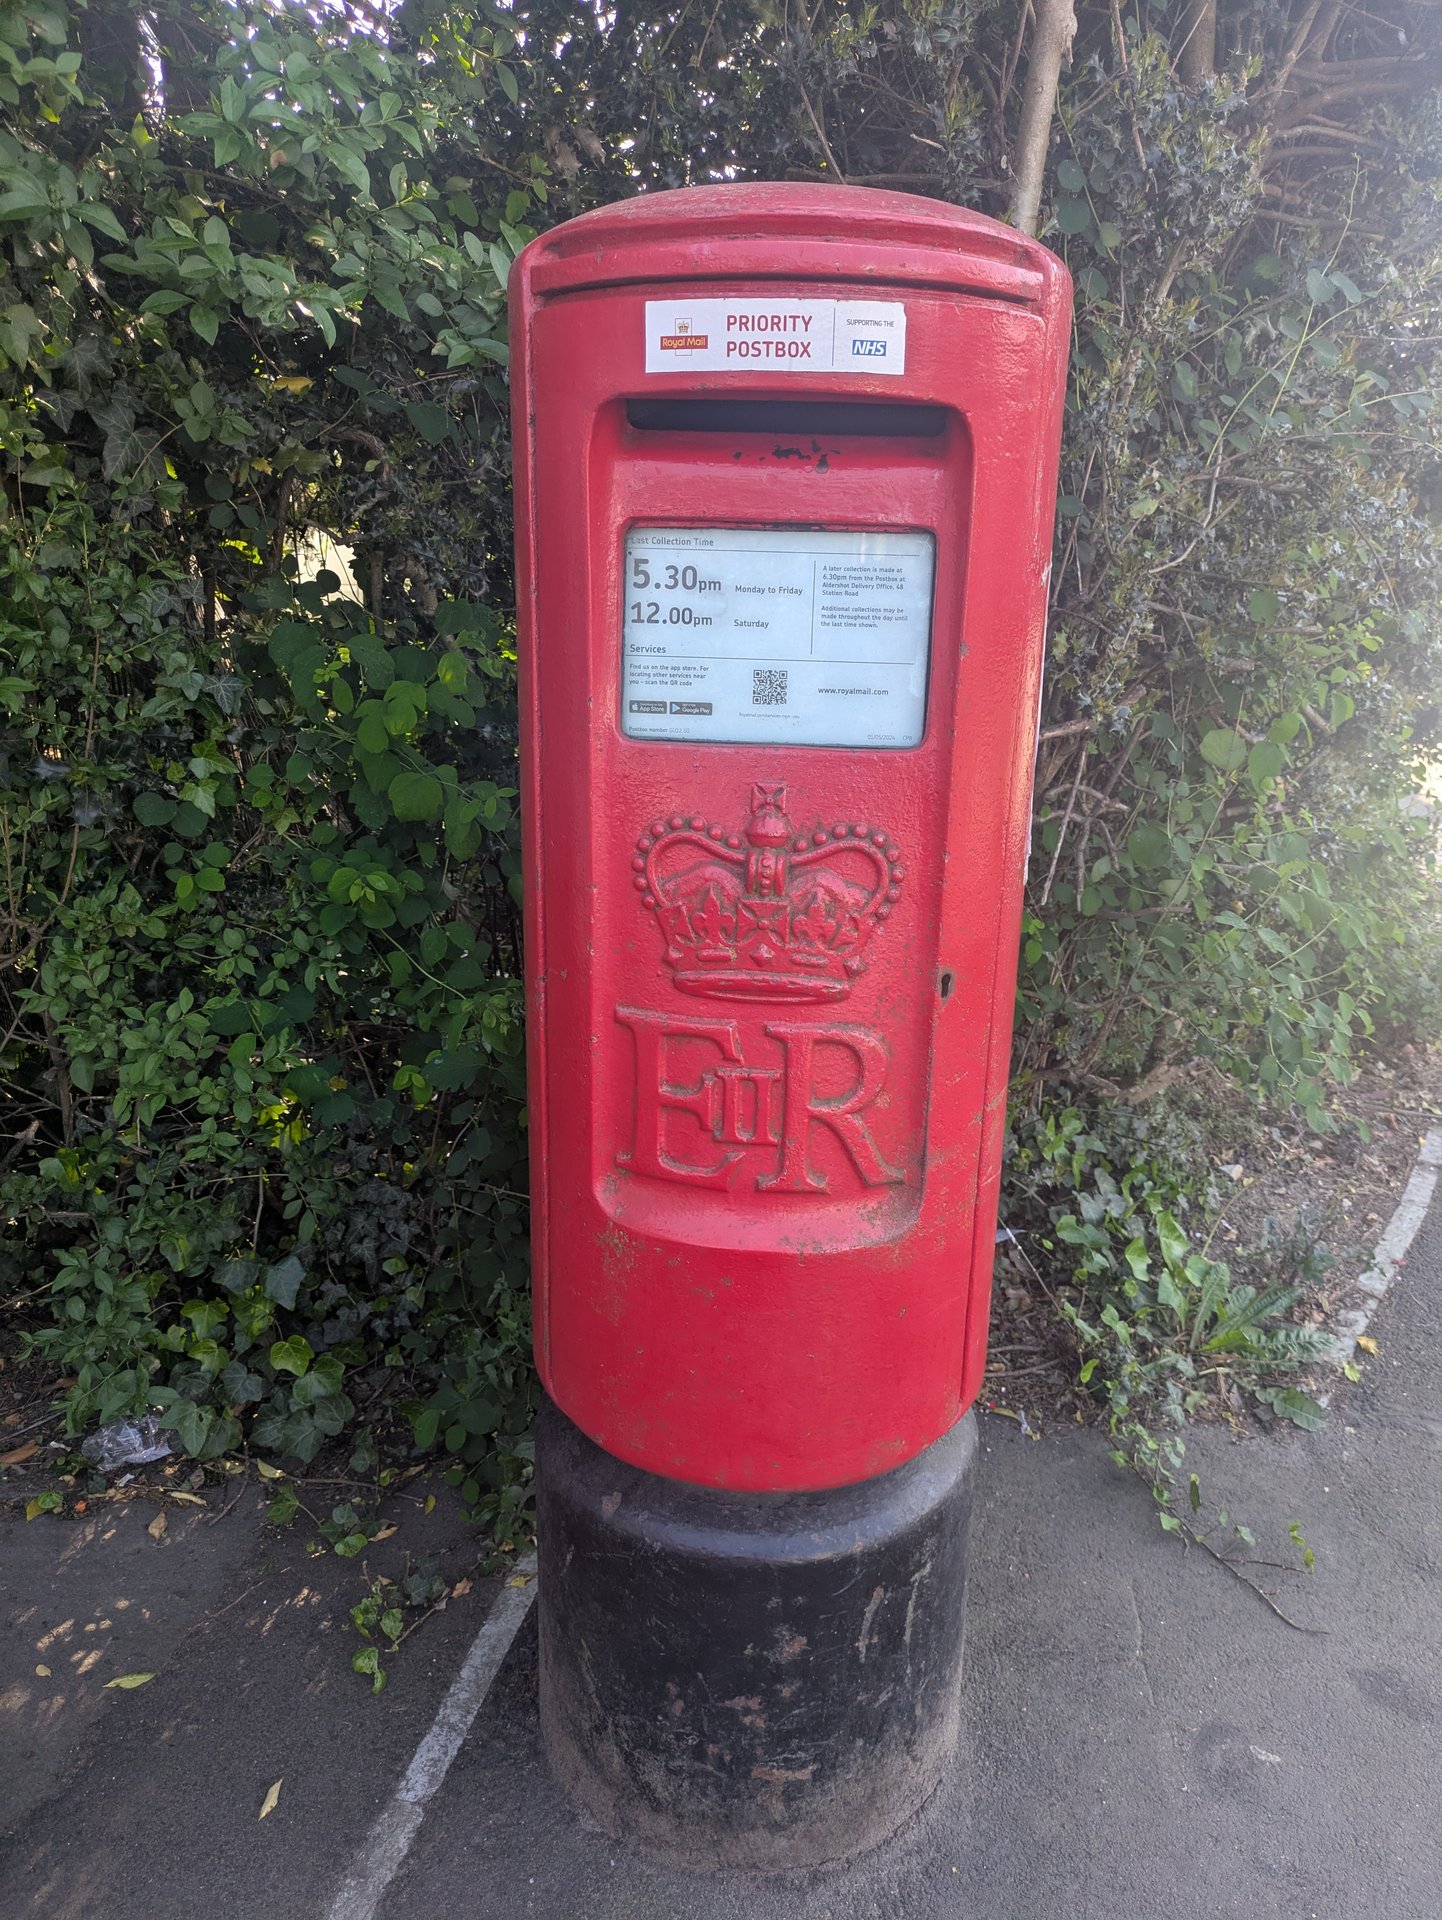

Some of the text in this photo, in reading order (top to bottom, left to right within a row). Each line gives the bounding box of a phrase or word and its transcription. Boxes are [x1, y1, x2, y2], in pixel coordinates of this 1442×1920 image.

[726, 314, 813, 333] PRIORITY
[846, 319, 895, 328] SUPPORTING THE
[662, 336, 707, 350] Royal Mail
[852, 340, 886, 356] NHS
[726, 341, 812, 358] POSTBOX
[631, 536, 714, 546] Last Collection Time
[632, 558, 803, 596] 5.30pm Monday to Friday
[822, 573, 847, 581] 6.30pm
[851, 582, 874, 590] Delivery
[630, 601, 770, 628] 12.00pm Saturday
[838, 613, 871, 621] throughout
[629, 643, 667, 654] Services
[817, 686, 889, 696] www.royalmail.com
